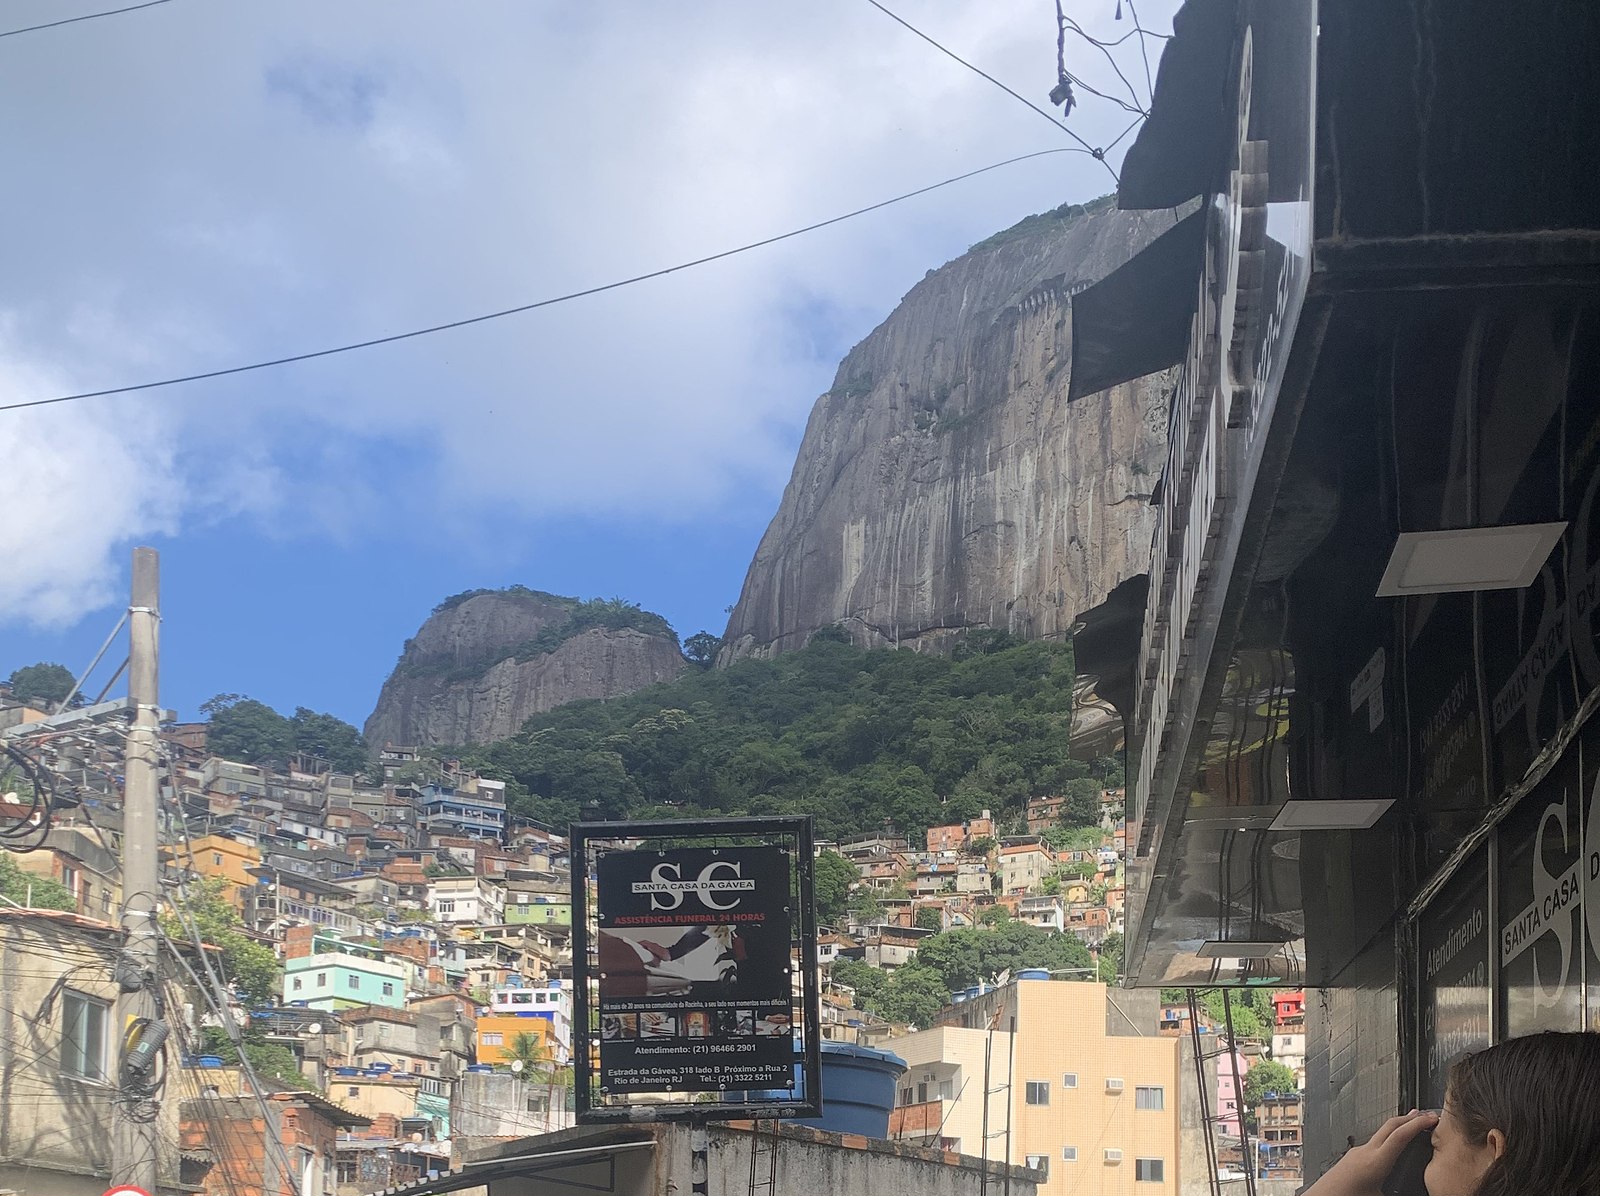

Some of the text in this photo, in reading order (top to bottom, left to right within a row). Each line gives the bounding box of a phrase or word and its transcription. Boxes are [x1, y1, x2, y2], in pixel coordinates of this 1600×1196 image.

[634, 880, 753, 891] SANTA CASA DA GÁVEA
[651, 861, 741, 910] SC
[614, 912, 766, 925] ASSISTÊNCIA FUNERAL 24 HORAS
[1504, 906, 1541, 955] SANTA
[1543, 871, 1579, 921] CASA
[1426, 906, 1482, 981] Atendimento
[634, 1044, 756, 1055] Atendimento: (21) 96466 2901
[608, 1068, 638, 1077] Estrada
[651, 1067, 678, 1075] Gávea,
[680, 1066, 694, 1074] 318
[695, 1066, 713, 1074] lado
[724, 1065, 757, 1073] Próximo
[765, 1064, 781, 1072] Rua
[782, 1064, 788, 1072] 2
[614, 1077, 628, 1085] Rio
[629, 1076, 640, 1084] de
[640, 1076, 671, 1084] Janeiro
[671, 1075, 683, 1083] RJ
[718, 1074, 733, 1084] (21)
[734, 1074, 753, 1082] 3322
[754, 1073, 772, 1081] 5211
